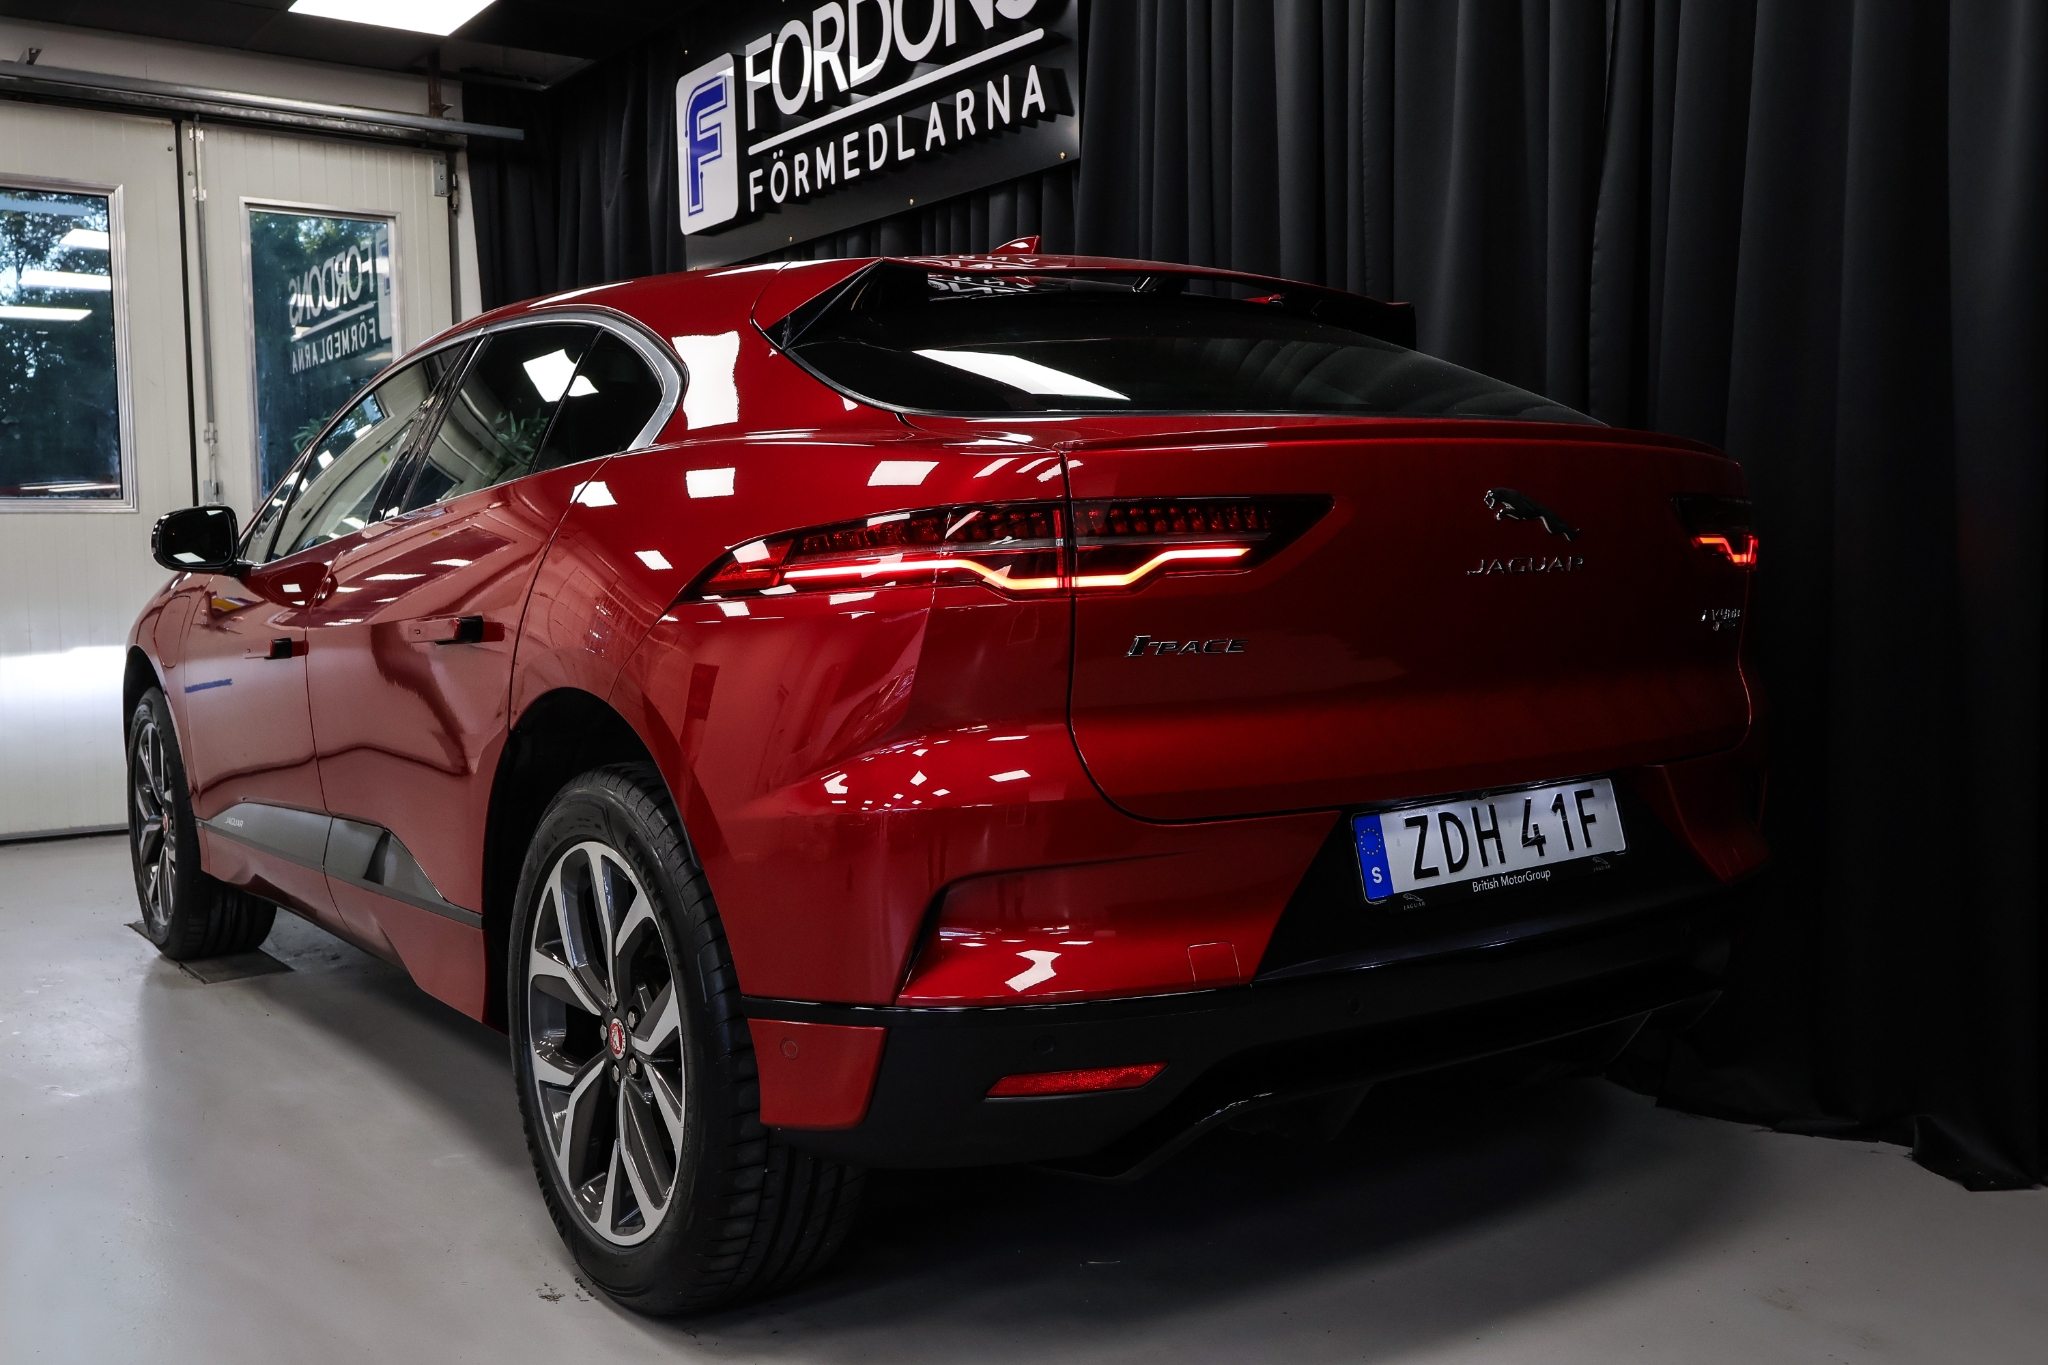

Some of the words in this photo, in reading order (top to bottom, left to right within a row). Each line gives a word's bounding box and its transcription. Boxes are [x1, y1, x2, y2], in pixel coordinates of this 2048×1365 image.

[745, 0, 1038, 131] FORDO
[747, 64, 1046, 212] FÖRMEDLARNA
[1467, 556, 1584, 575] JAGUAR
[1404, 803, 1506, 880] ZDH
[1521, 788, 1597, 857] 41F
[1372, 866, 1383, 884] S
[1472, 875, 1499, 893] British
[1500, 868, 1551, 887] MotorGroup
[1403, 901, 1426, 911] JAGUAR
